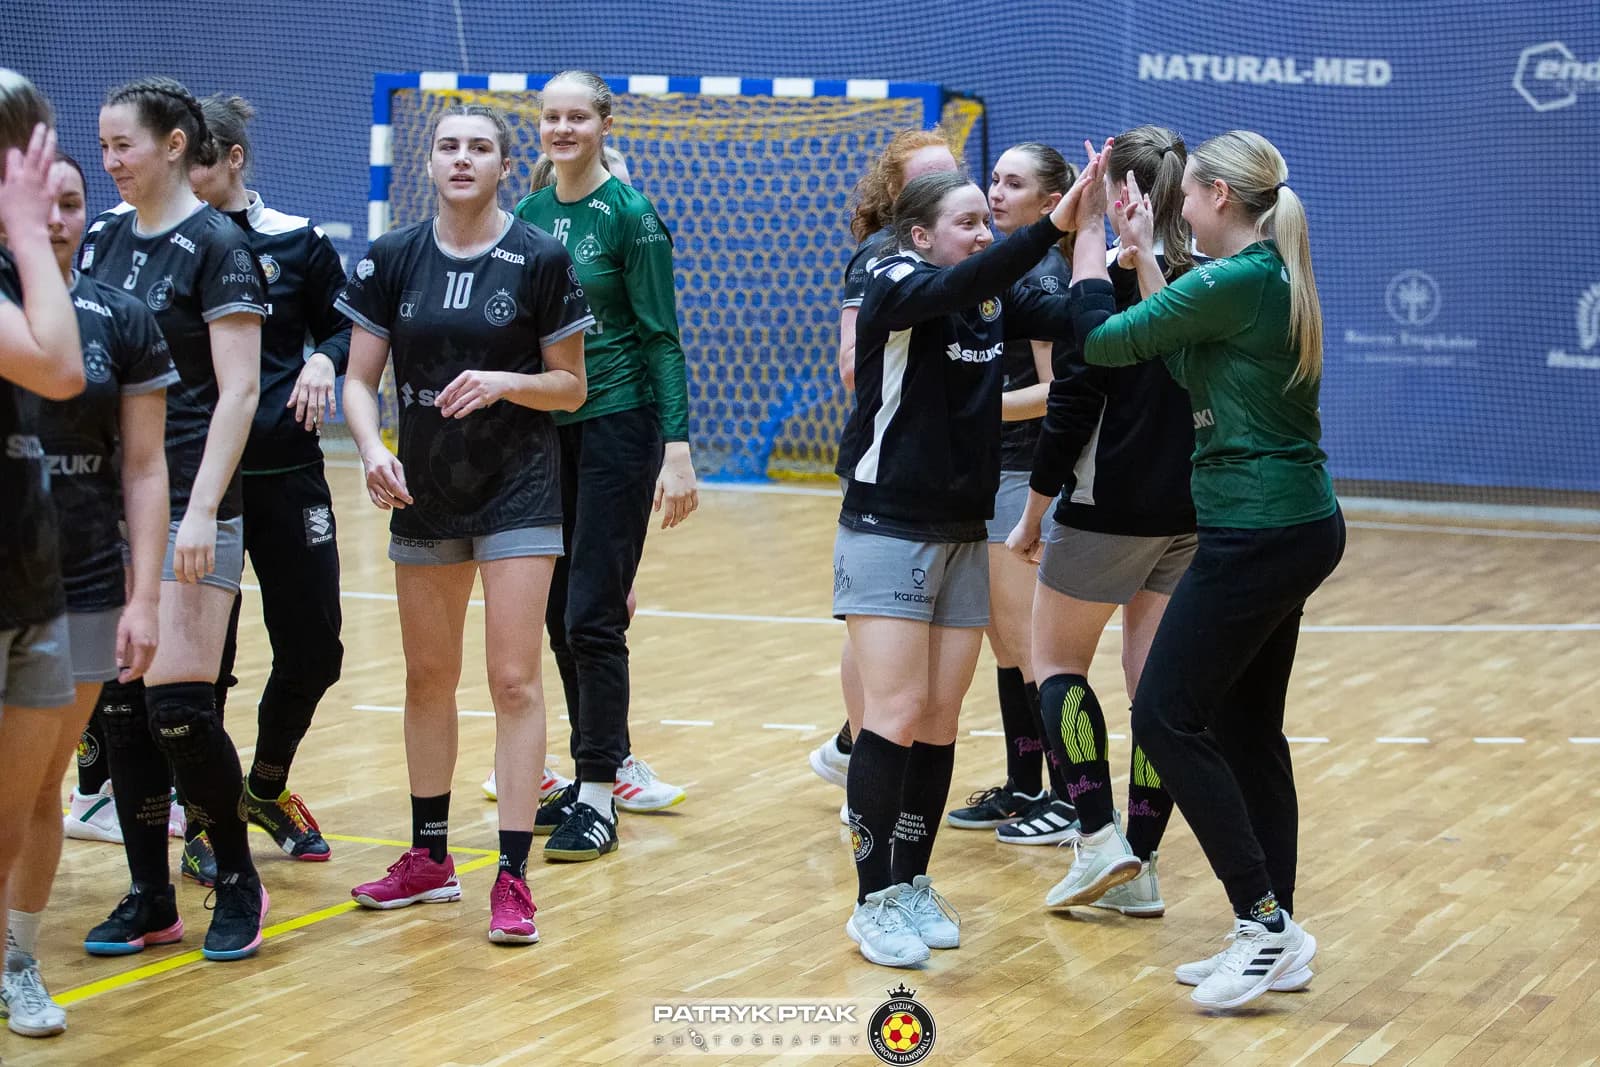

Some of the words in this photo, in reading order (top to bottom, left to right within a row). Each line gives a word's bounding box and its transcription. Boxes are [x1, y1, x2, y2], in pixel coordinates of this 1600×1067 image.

[1138, 53, 1392, 87] NATURAL-MED
[553, 218, 571, 247] 16
[123, 250, 149, 290] 5
[443, 271, 475, 309] 10
